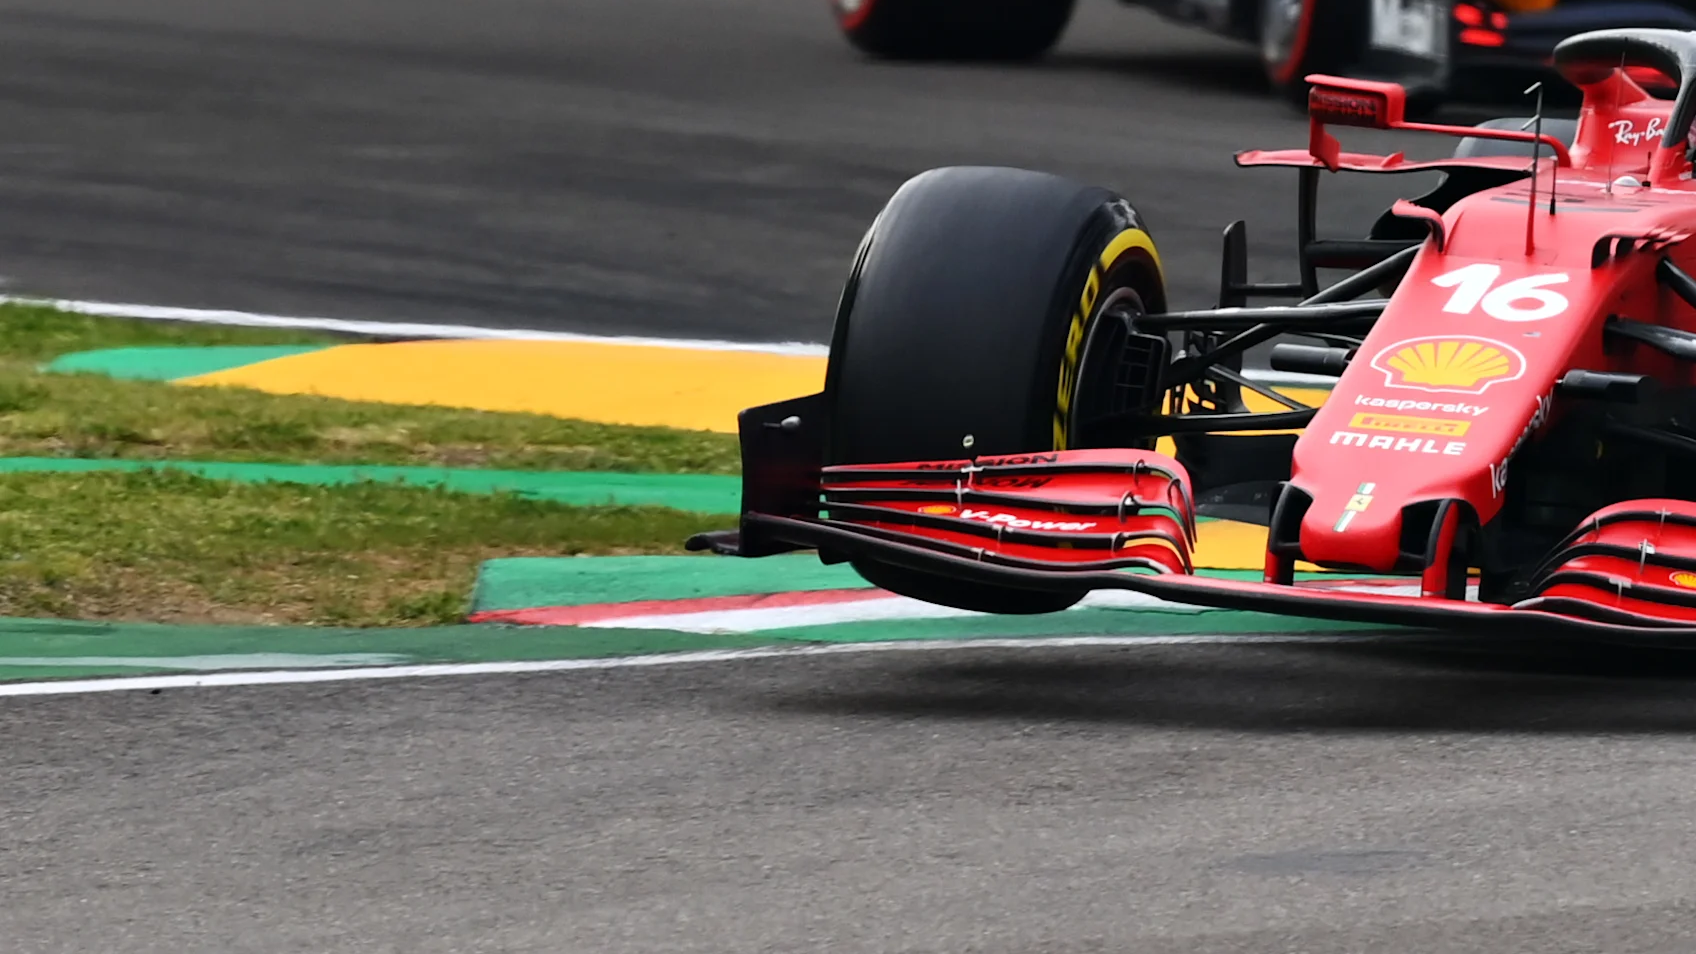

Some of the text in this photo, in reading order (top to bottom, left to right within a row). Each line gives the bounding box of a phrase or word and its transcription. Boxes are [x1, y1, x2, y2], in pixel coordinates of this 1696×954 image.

[1608, 118, 1666, 146] Ray-Ba
[1431, 263, 1569, 322] 16
[1053, 264, 1101, 452] ZERO
[1355, 394, 1489, 416] kaspersky
[1360, 416, 1460, 434] PIRELLI
[1329, 431, 1467, 456] MAHLE
[960, 508, 1097, 531] V-Power
